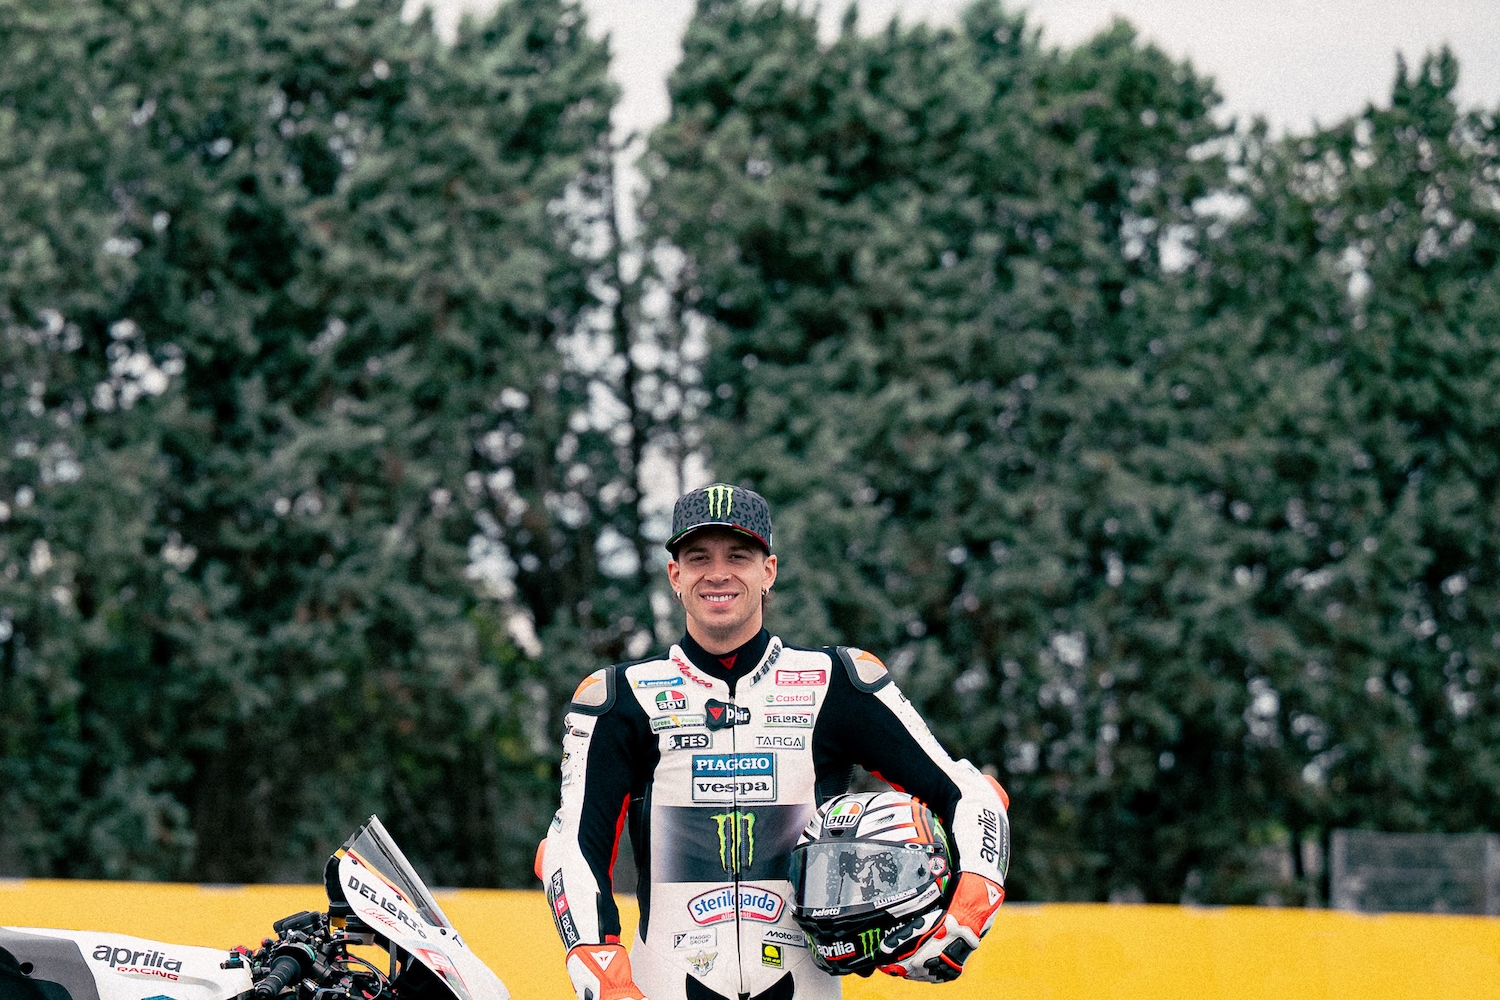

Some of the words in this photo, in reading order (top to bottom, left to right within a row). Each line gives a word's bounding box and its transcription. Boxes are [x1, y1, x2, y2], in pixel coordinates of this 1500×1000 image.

[671, 655, 713, 689] Marco
[777, 671, 821, 681] BS
[659, 700, 685, 710] agv
[775, 694, 812, 703] Castrol
[653, 720, 671, 728] Green
[681, 735, 706, 747] FES
[755, 735, 803, 747] TARGA
[696, 757, 770, 772] PIAGGIO
[696, 779, 770, 796] vespa
[828, 814, 856, 828] agv
[979, 808, 998, 864] aprilia
[552, 871, 562, 895] #be
[561, 913, 577, 943] racer
[694, 889, 776, 917] sterilgarda
[811, 907, 841, 918] belotti
[689, 933, 712, 941] PIAGGIO
[817, 941, 855, 957] aprilia
[92, 944, 183, 973] aprilia
[116, 966, 179, 981] RACING
